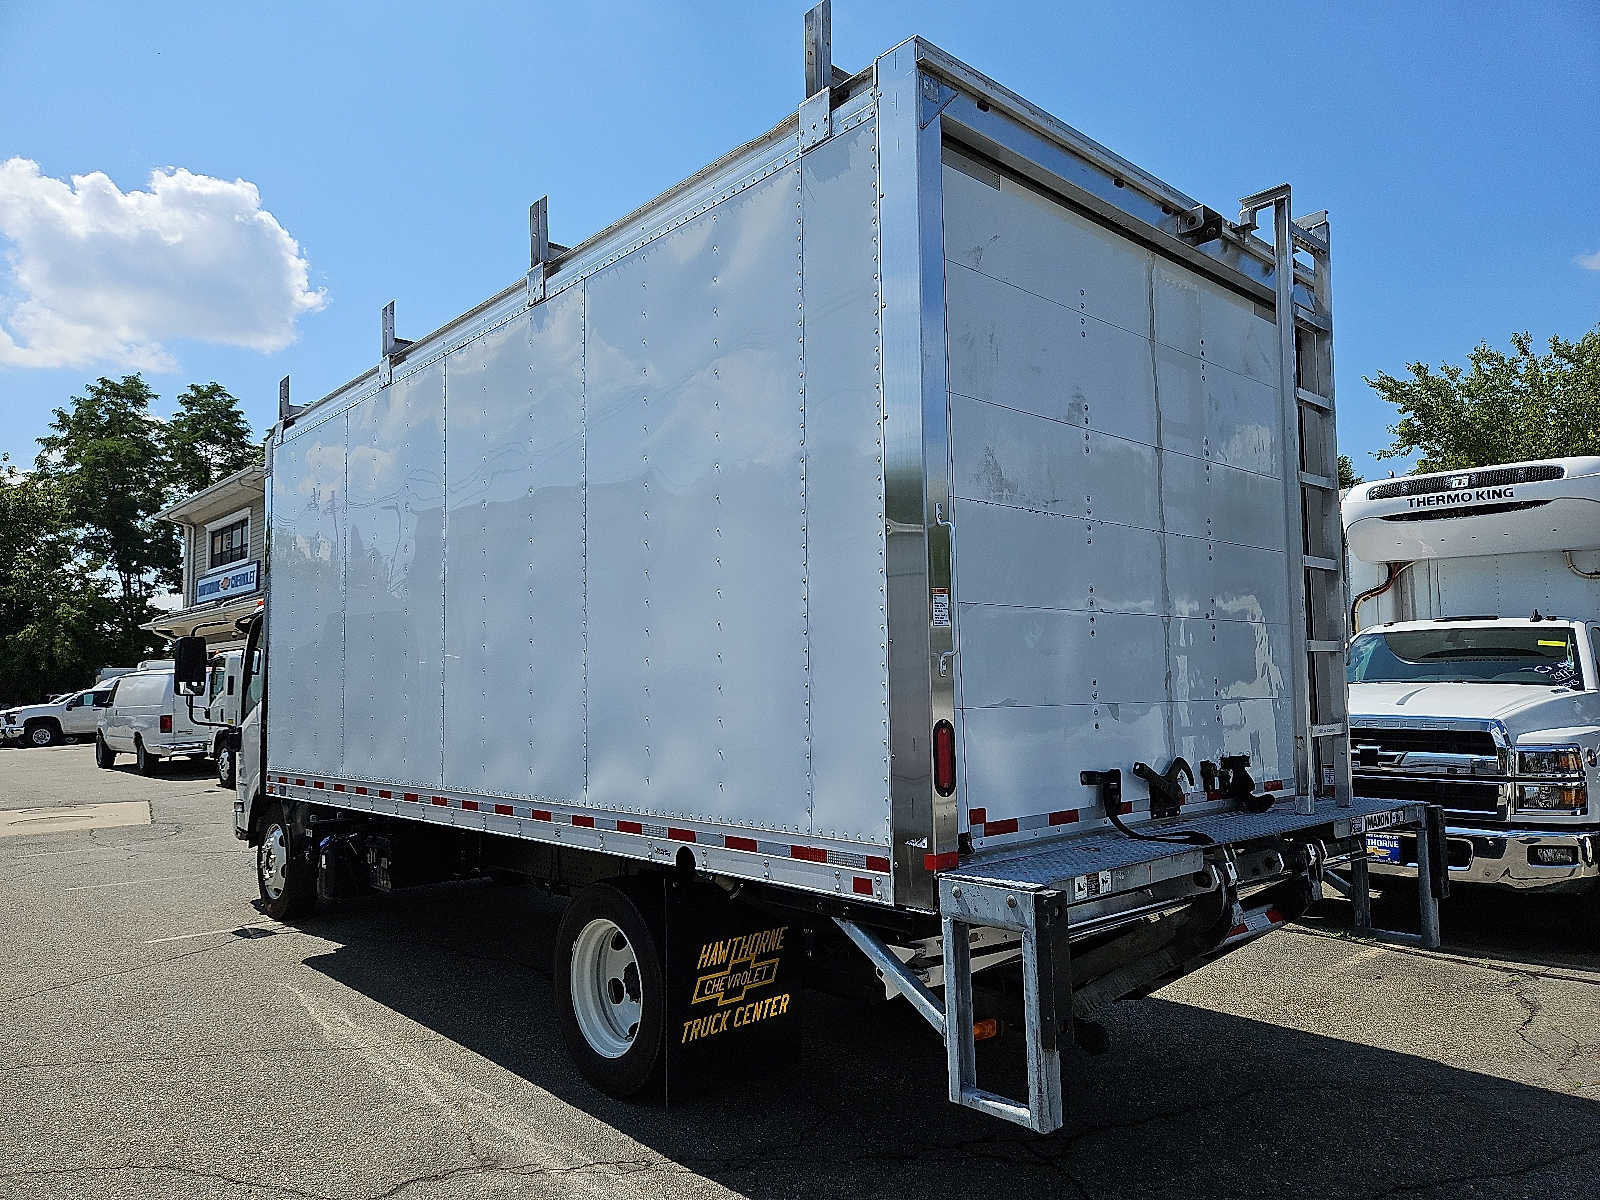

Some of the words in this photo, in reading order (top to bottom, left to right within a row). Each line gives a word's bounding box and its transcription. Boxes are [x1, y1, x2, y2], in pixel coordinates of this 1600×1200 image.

[1406, 492, 1473, 508] THERMO
[1475, 487, 1515, 501] KING
[1349, 718, 1457, 732] VROLET
[1365, 838, 1400, 848] THORNE
[697, 926, 788, 969] HAWTHORNE
[704, 965, 769, 995] CHEVROLET
[682, 1009, 731, 1043] TRUCK
[733, 993, 790, 1027] CENTER
